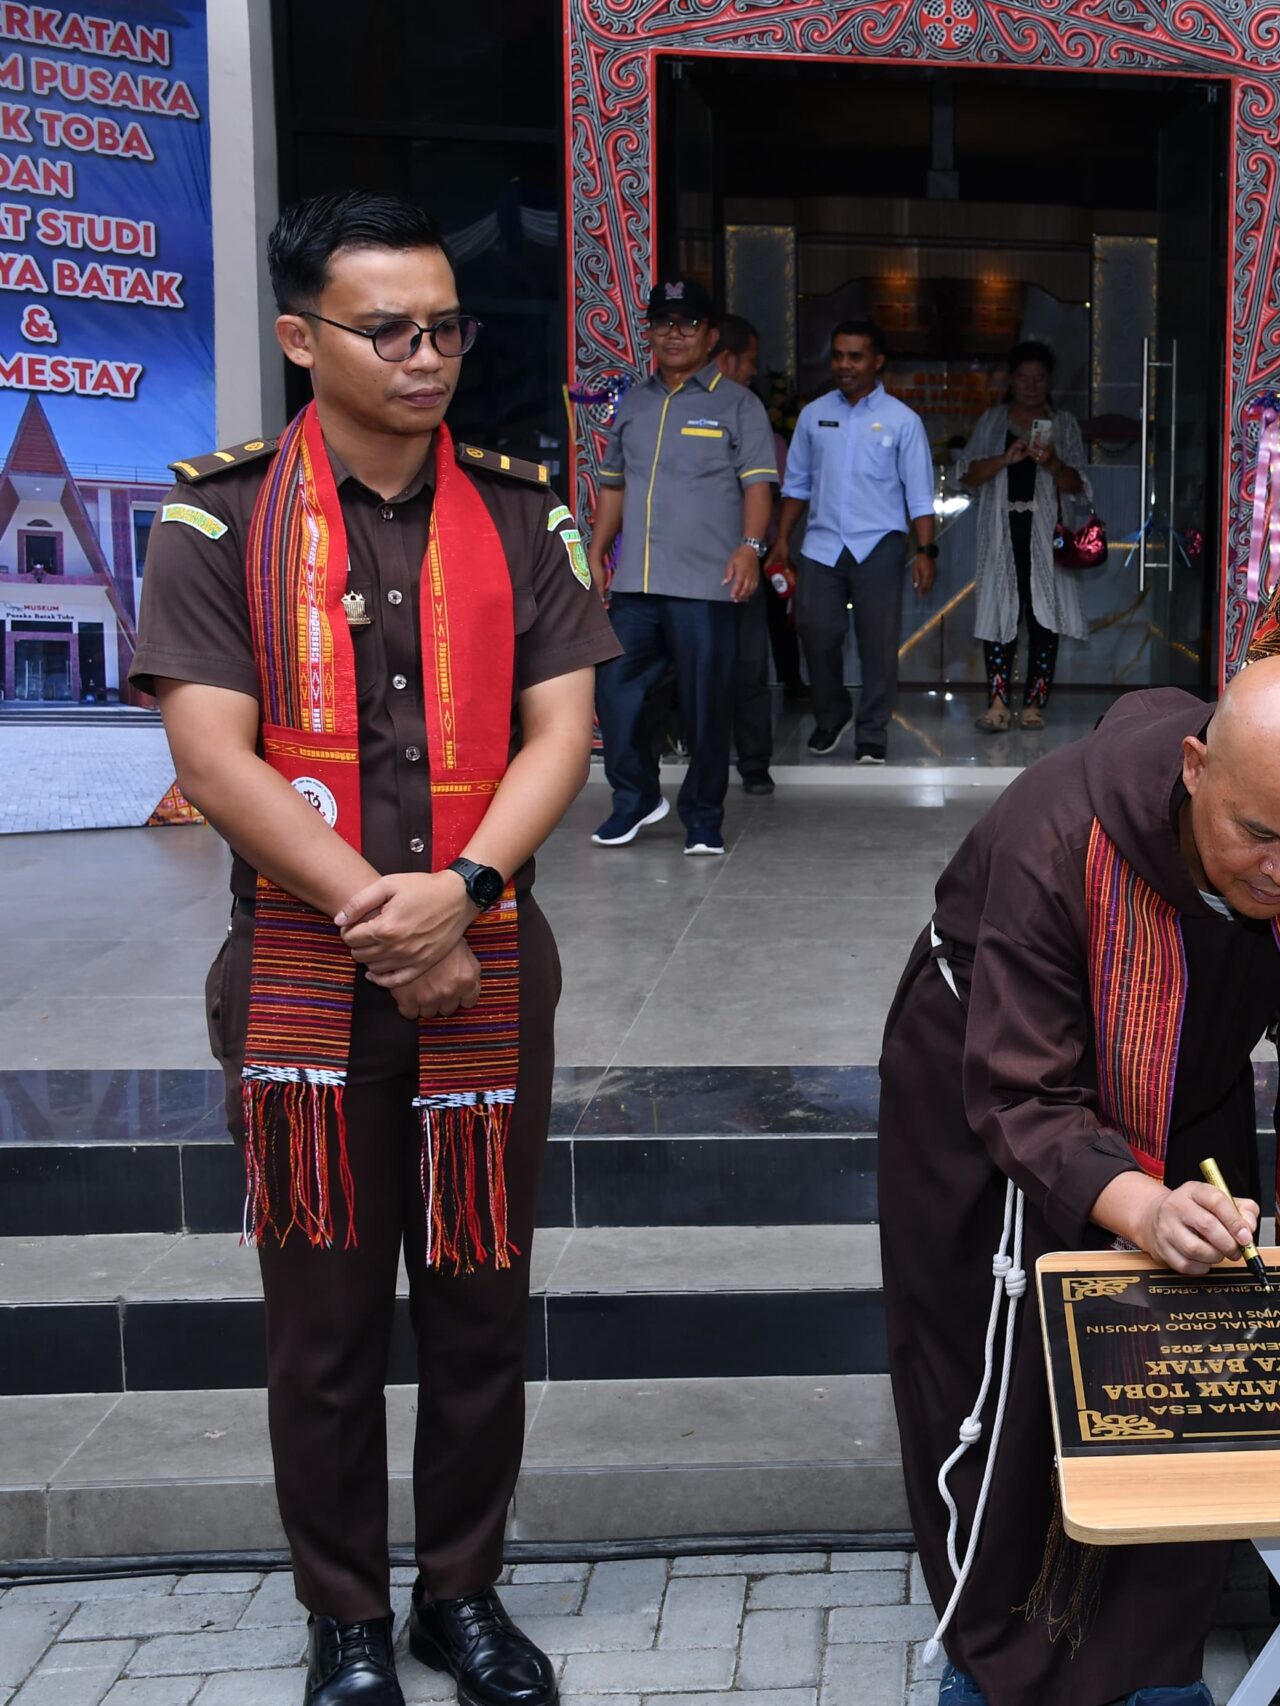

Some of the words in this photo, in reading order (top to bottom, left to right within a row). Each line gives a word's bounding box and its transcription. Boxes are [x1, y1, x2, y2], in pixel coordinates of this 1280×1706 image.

[0, 3, 168, 64] RKATAN
[33, 59, 198, 117] PUSAKA
[37, 110, 152, 159] TOBA
[39, 211, 154, 255] STUDI
[54, 260, 182, 306] BATAK
[22, 306, 55, 341] &
[1255, 1284, 1274, 1292] IO
[1170, 1311, 1233, 1321] MEDAN
[1086, 1324, 1161, 1334] KAPUSIN
[1166, 1322, 1217, 1331] ORDO
[1160, 1344, 1203, 1354] 2025
[1145, 1358, 1248, 1376] BATAK
[1102, 1383, 1190, 1400] TOBA
[1149, 1404, 1203, 1416] ESA
